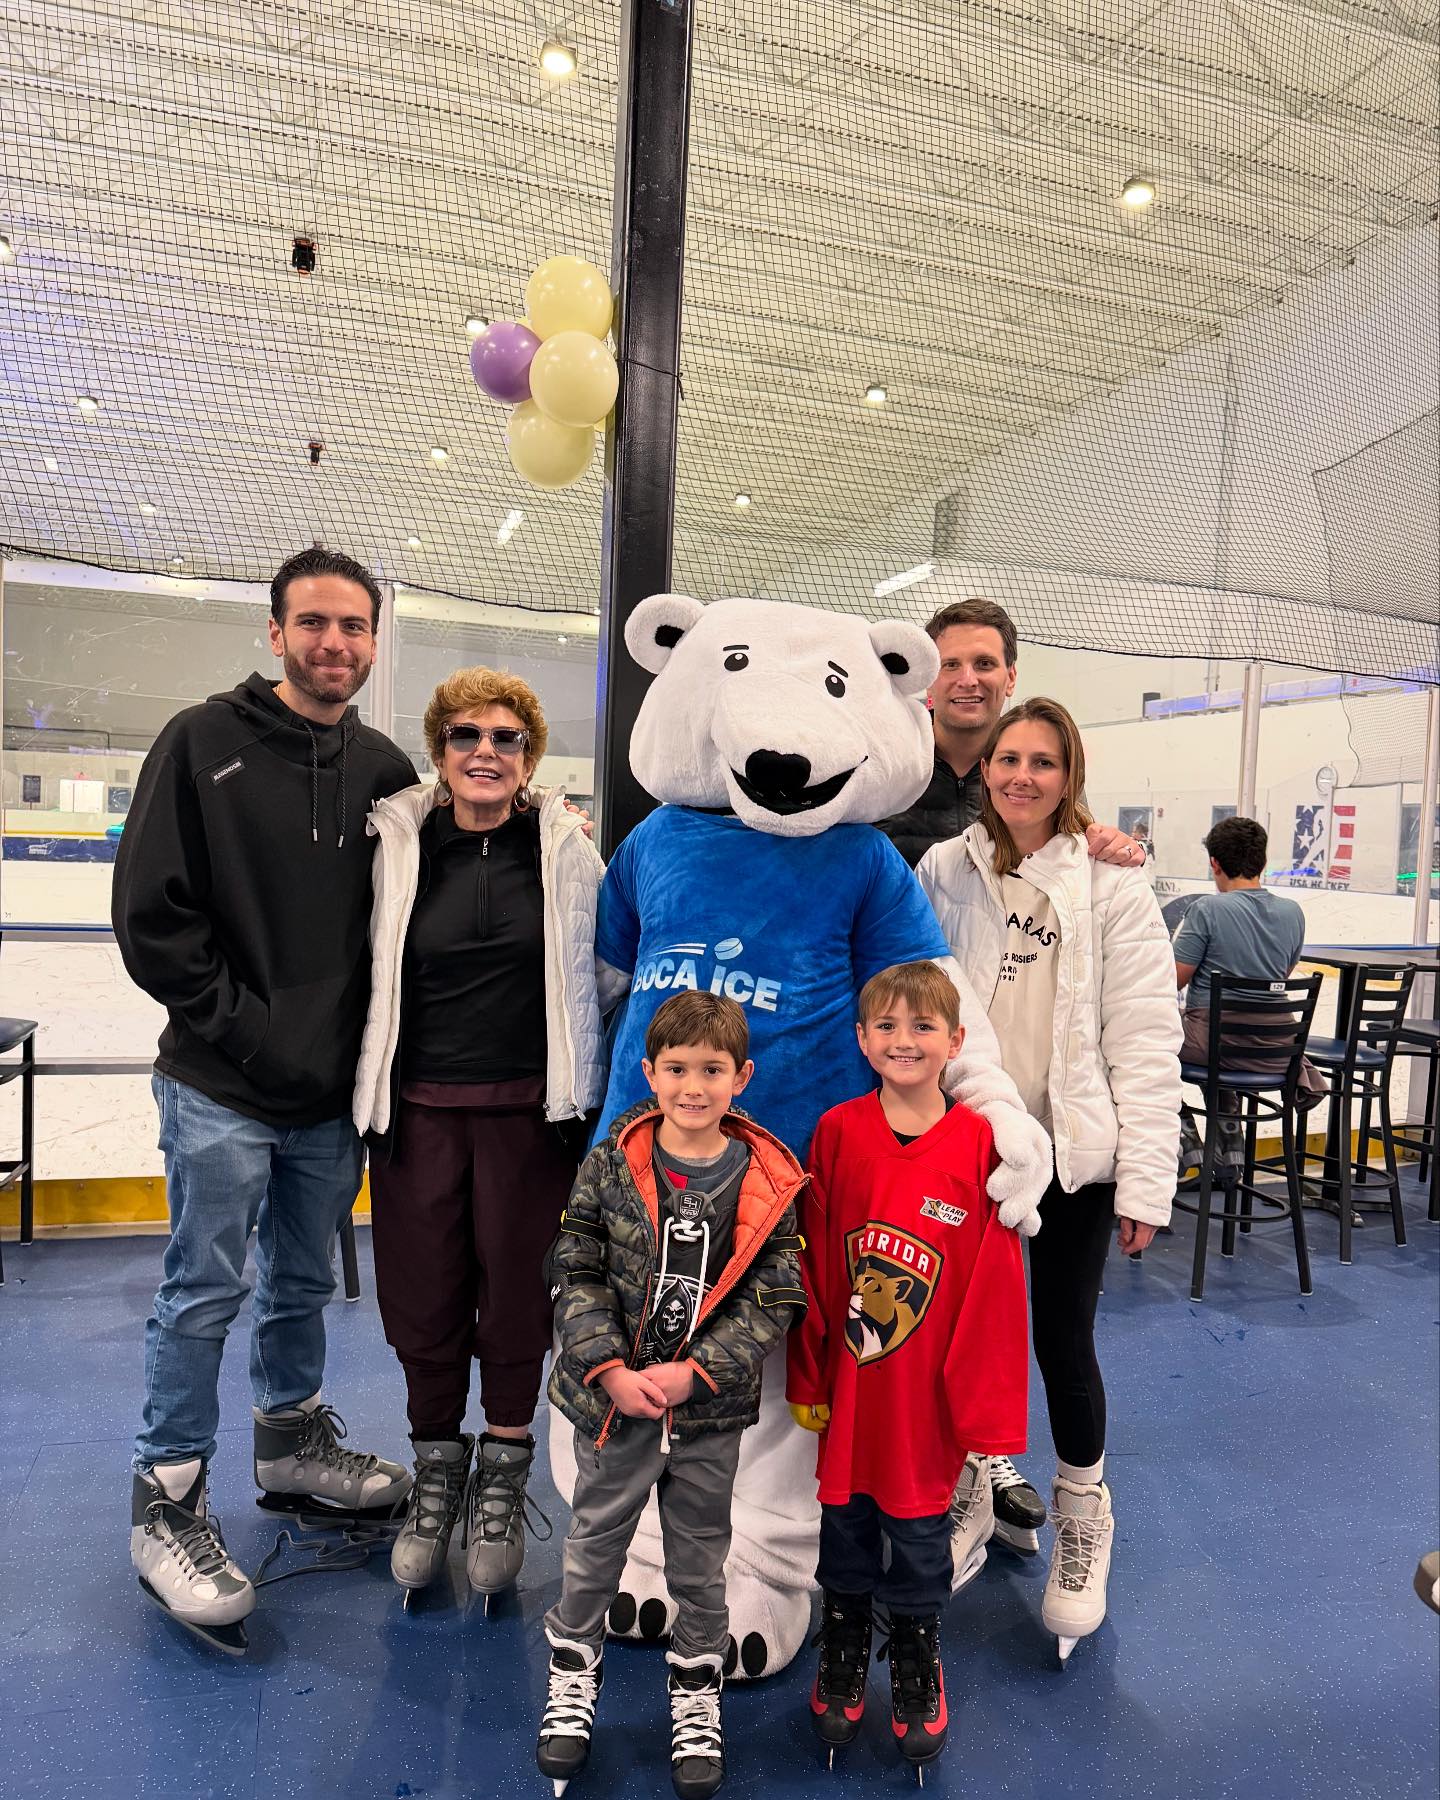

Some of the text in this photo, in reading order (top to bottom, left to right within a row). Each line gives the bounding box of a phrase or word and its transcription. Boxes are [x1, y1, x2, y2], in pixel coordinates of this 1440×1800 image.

[1290, 879, 1307, 888] USA
[1006, 912, 1057, 946] ARAS
[633, 959, 698, 993] BOCA
[941, 1204, 965, 1217] LEARN
[943, 1213, 961, 1223] PLAY
[858, 1231, 929, 1273] FORIDA
